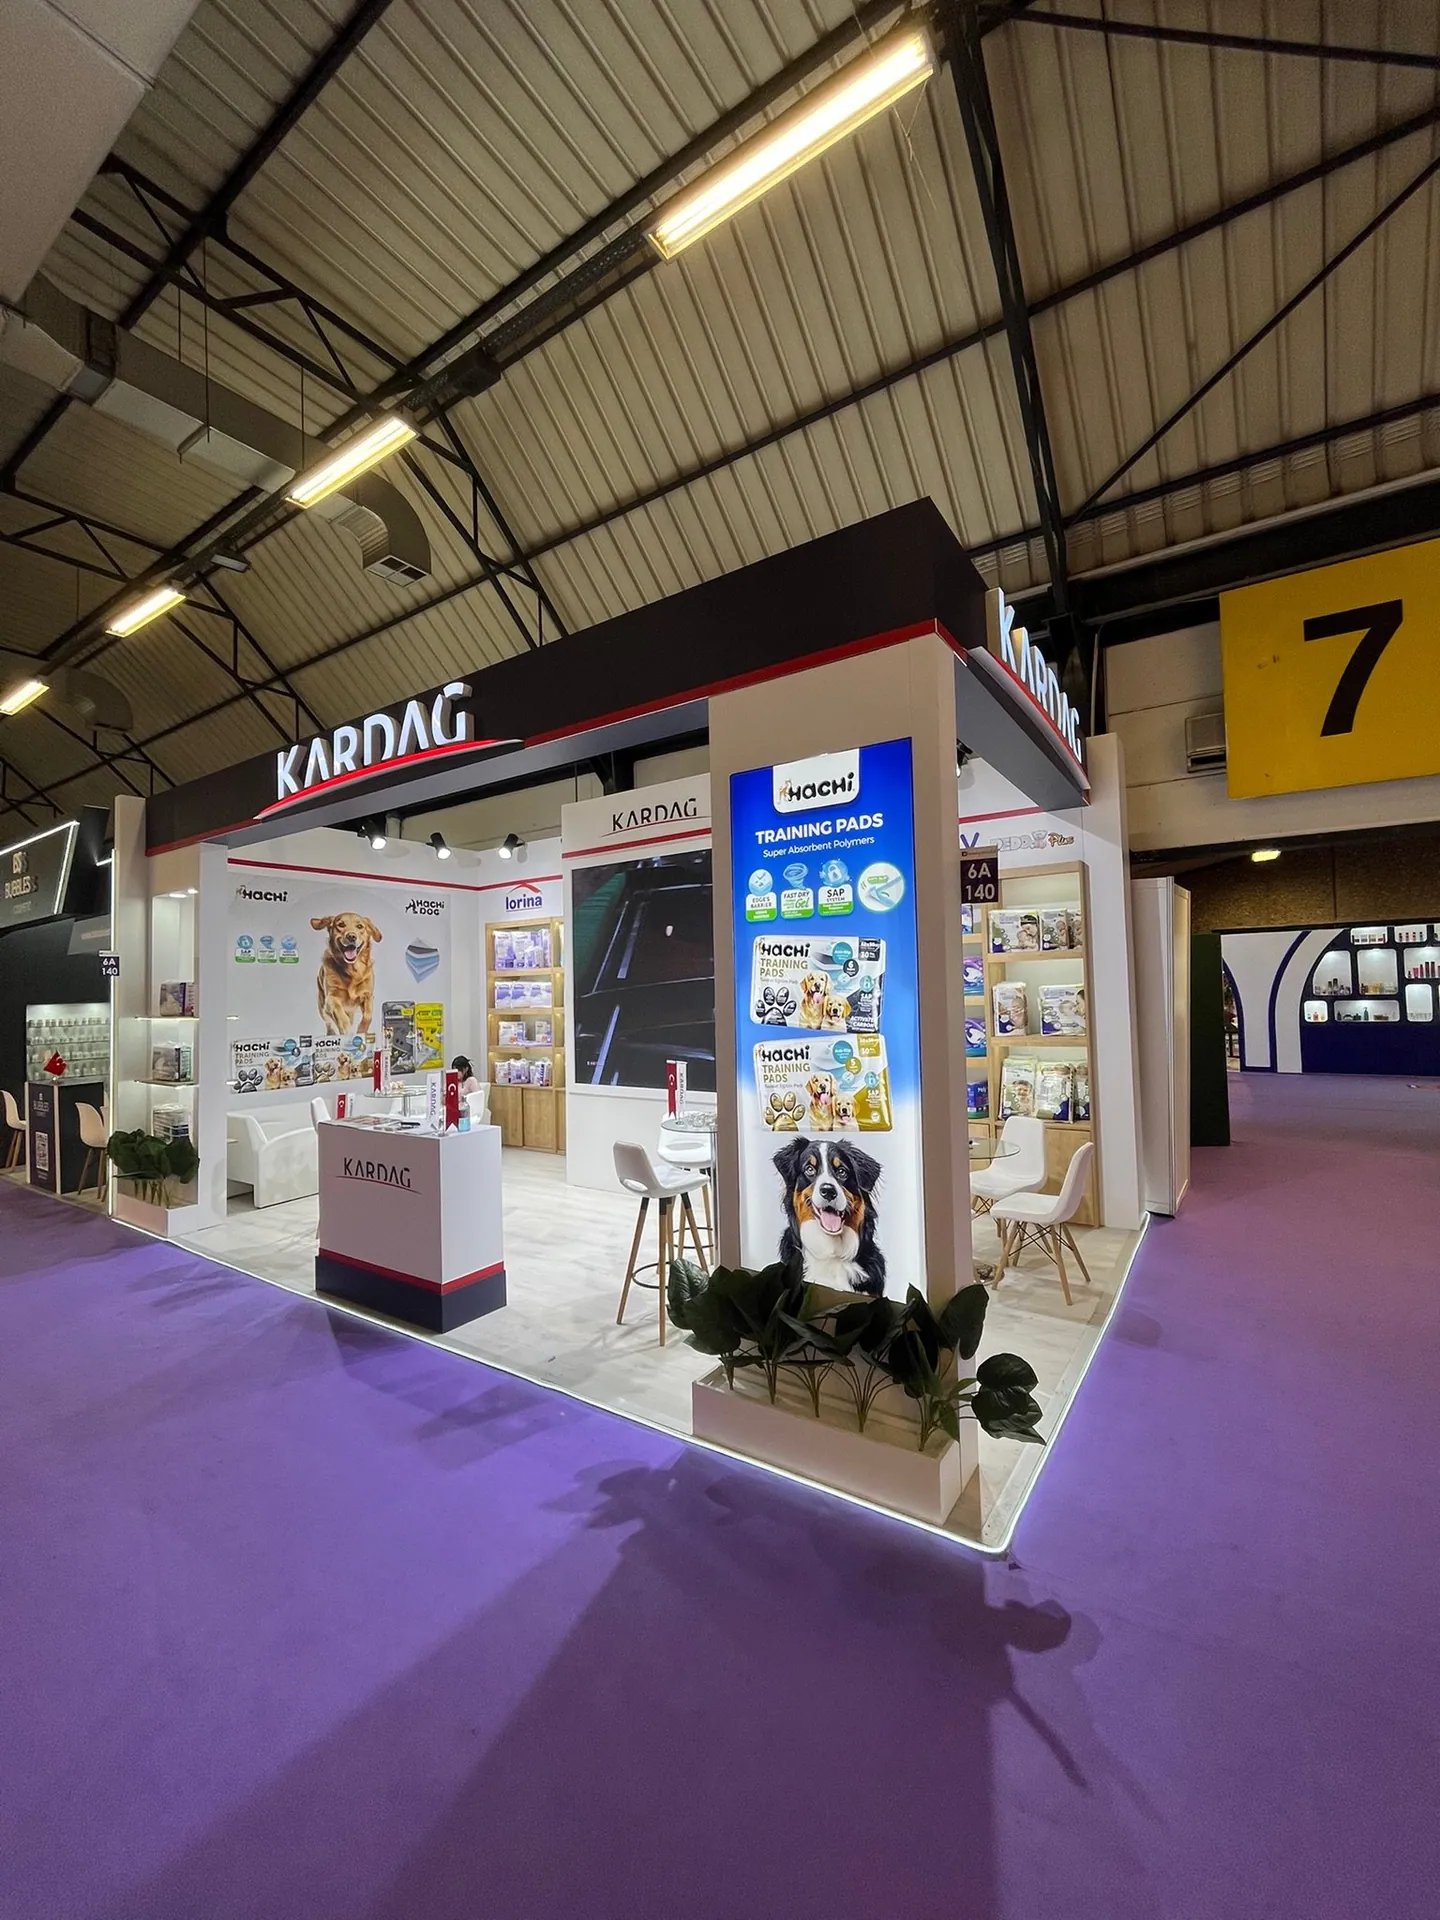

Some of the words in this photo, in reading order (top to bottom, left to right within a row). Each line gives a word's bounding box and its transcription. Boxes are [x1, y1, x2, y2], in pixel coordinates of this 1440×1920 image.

[1303, 598, 1404, 738] 7
[755, 820, 832, 845] TRAINING
[835, 812, 884, 831] PADS
[762, 846, 787, 859] Super
[788, 840, 832, 855] Absorbent
[833, 836, 875, 850] Polymers
[967, 862, 992, 879] 6A
[827, 888, 845, 898] SAP
[965, 884, 995, 901] 140
[505, 892, 543, 911] lorina
[419, 907, 440, 916] DOG
[102, 958, 116, 966] 6A
[760, 958, 809, 970] TRAINING
[102, 967, 118, 976] 140
[760, 968, 784, 978] PADS
[762, 1063, 811, 1074] TRAINING
[763, 1074, 788, 1084] PADS
